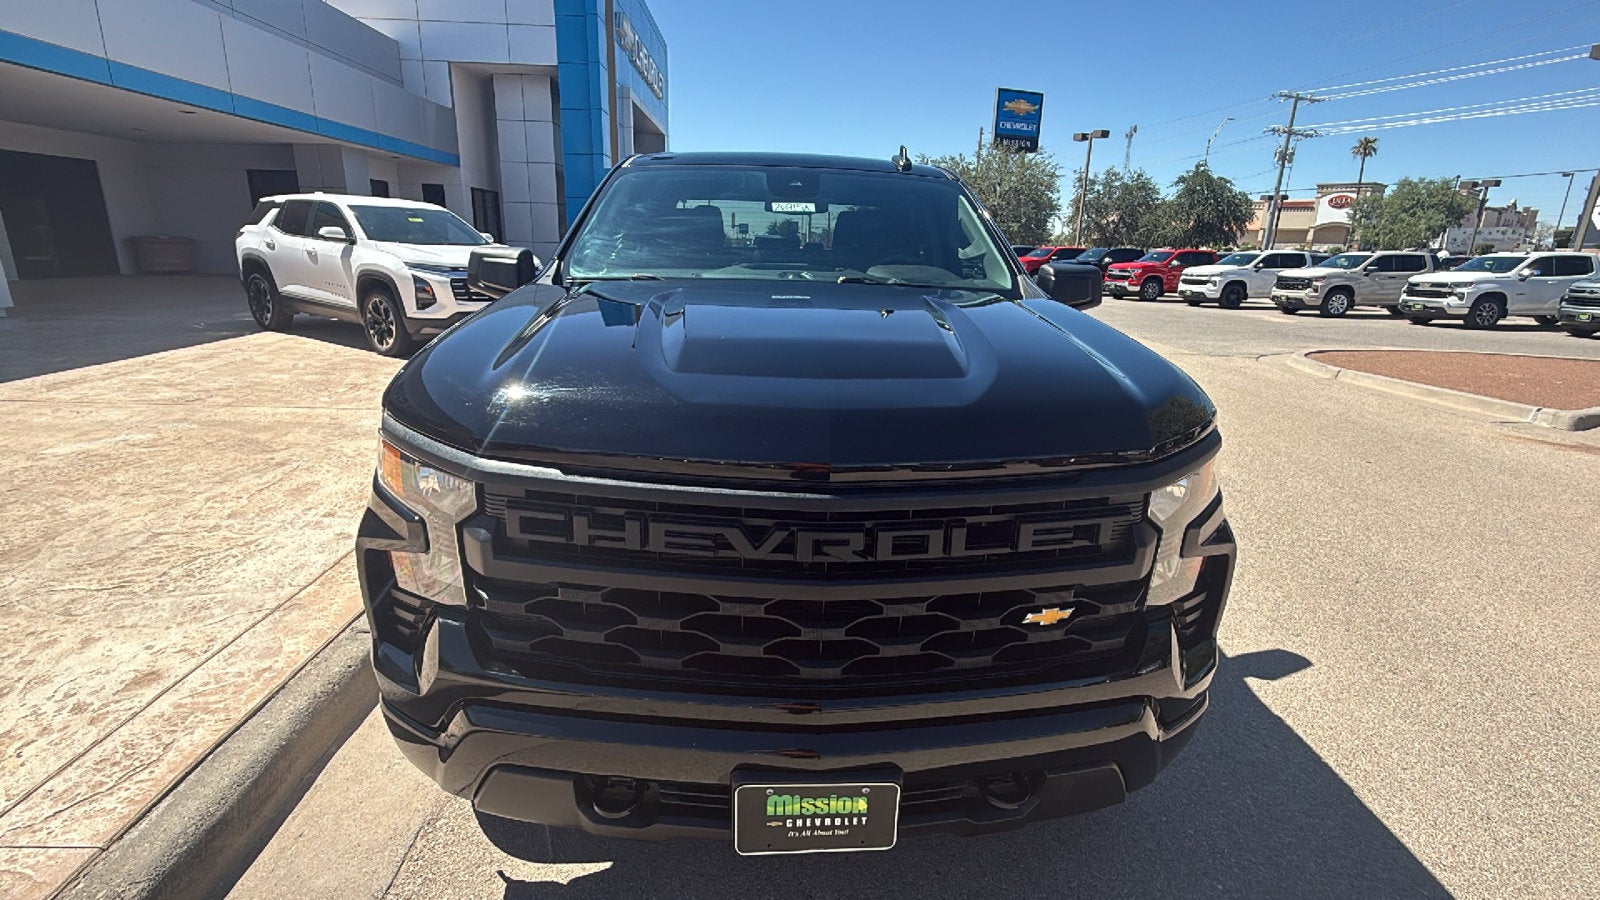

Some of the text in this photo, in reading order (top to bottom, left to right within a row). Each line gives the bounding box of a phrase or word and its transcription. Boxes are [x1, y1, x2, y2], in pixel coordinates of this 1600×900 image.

[1000, 121, 1037, 131] CHEVROLET
[505, 510, 1114, 563] CHEVROLET
[767, 794, 867, 815] Mission
[786, 817, 867, 827] CHEVROLET
